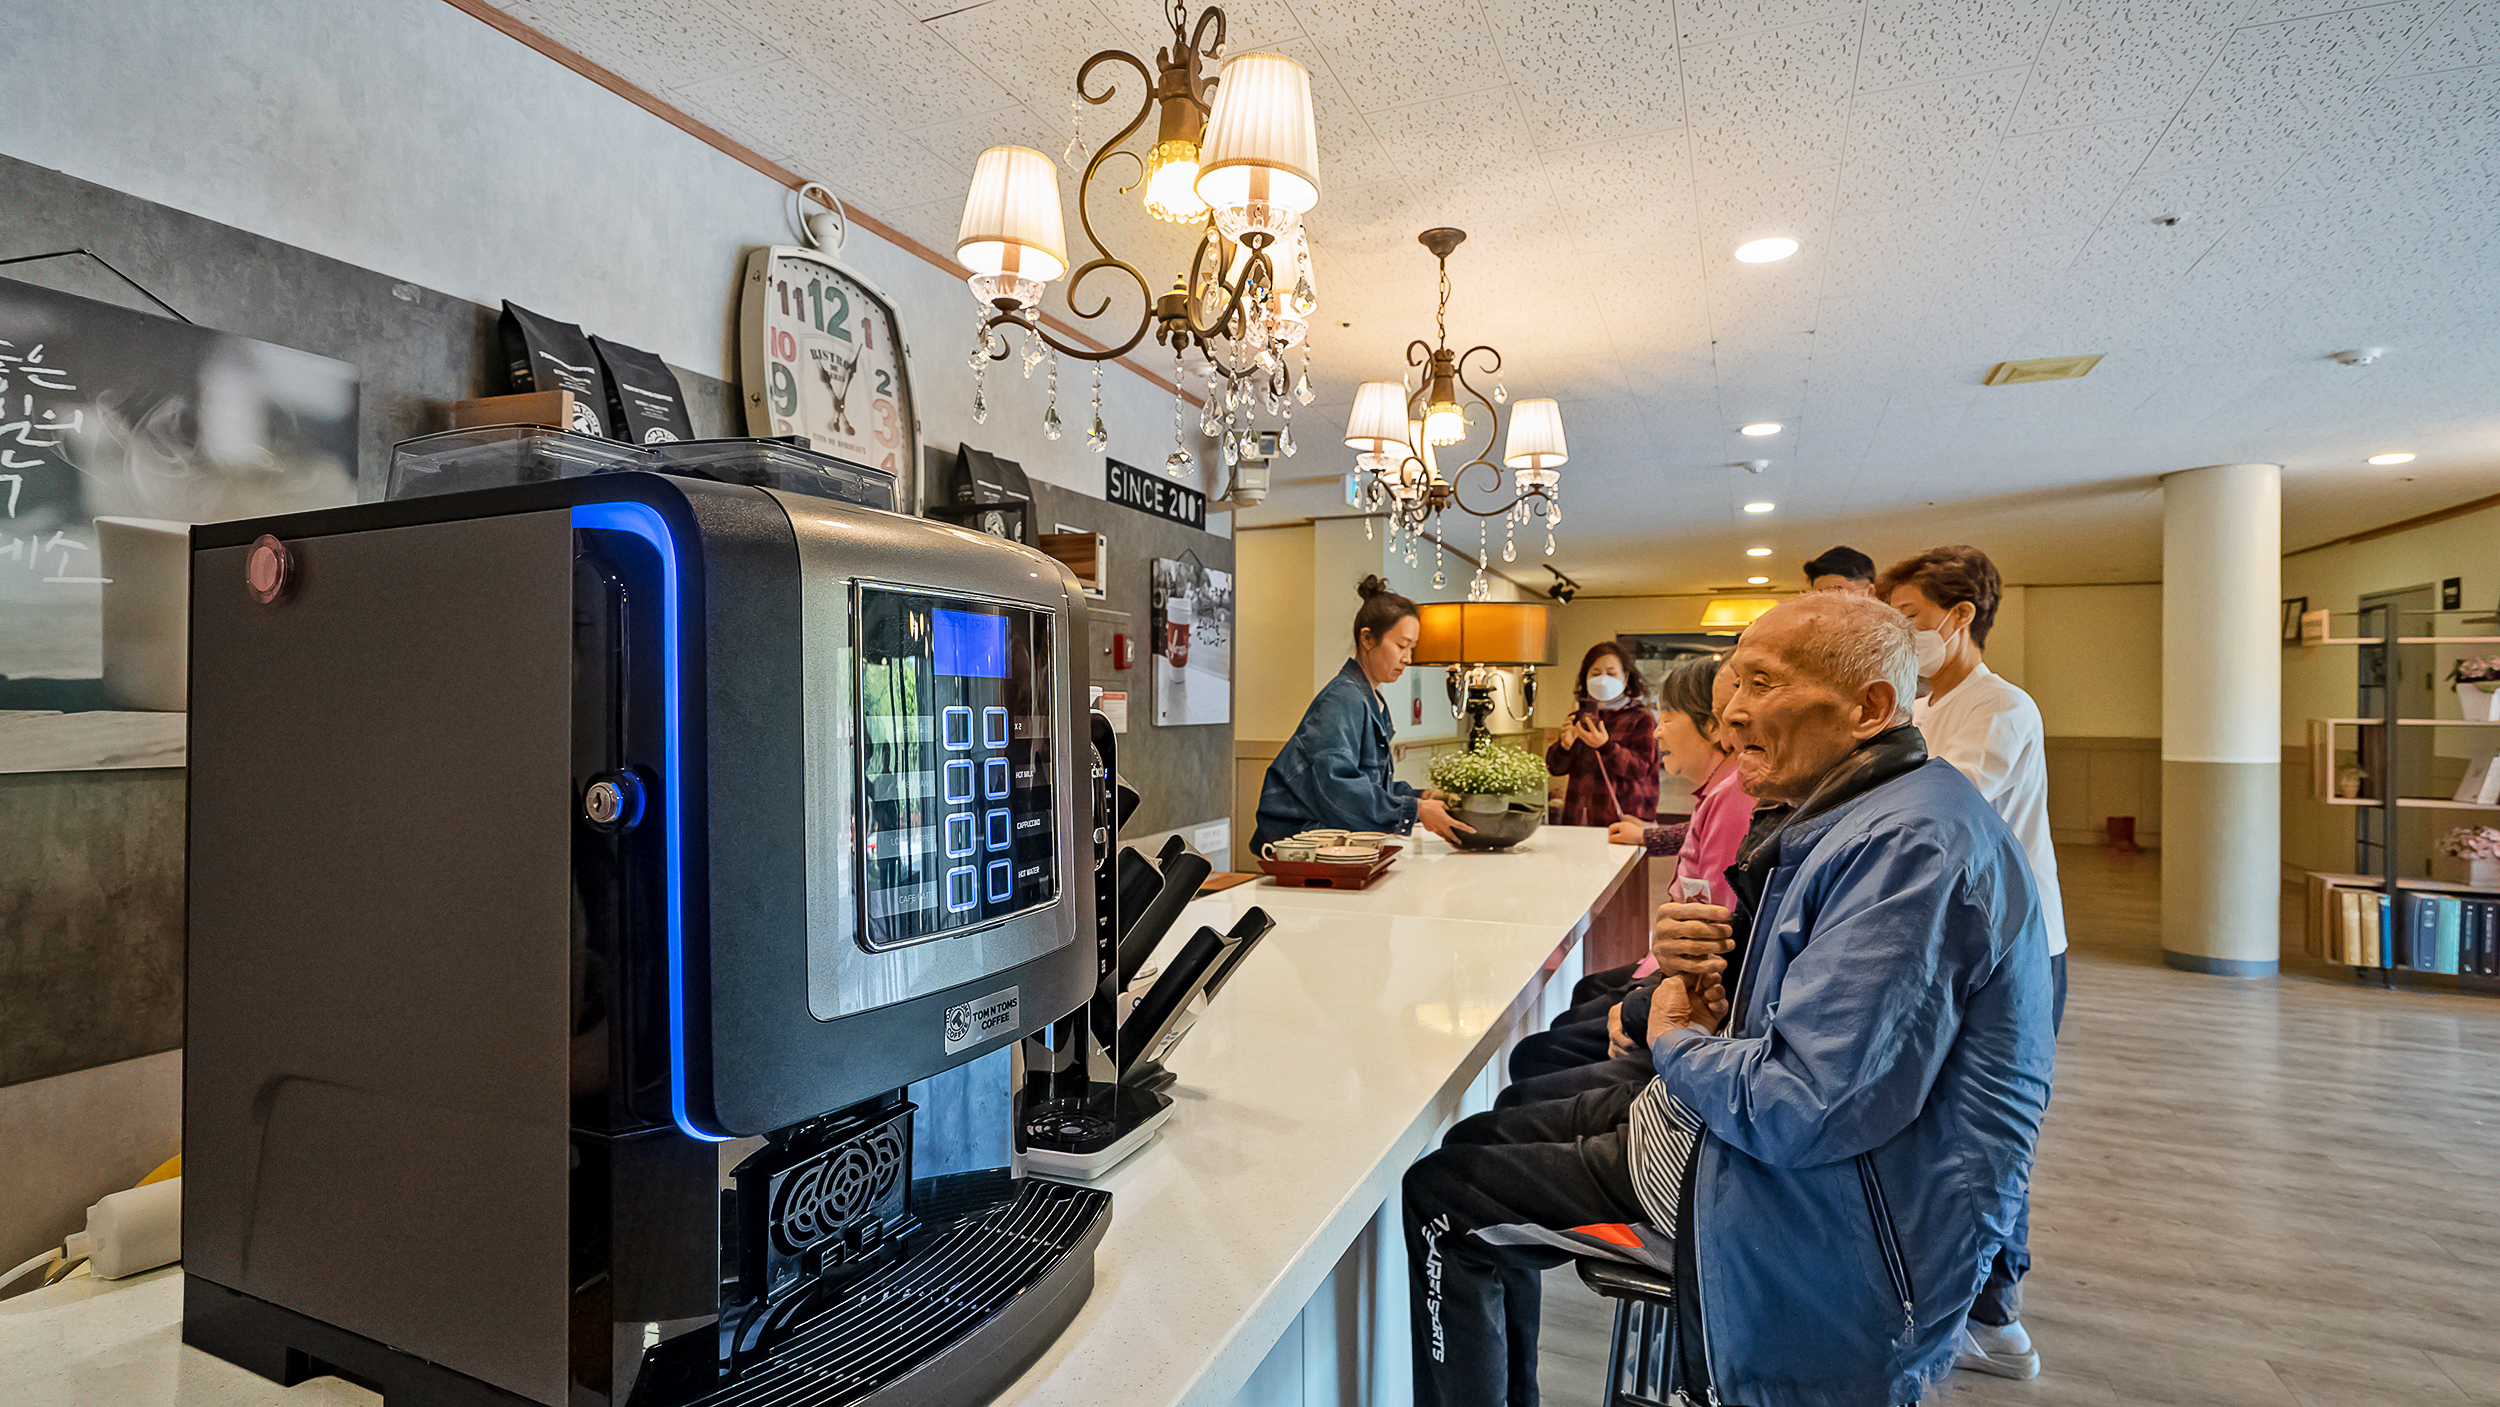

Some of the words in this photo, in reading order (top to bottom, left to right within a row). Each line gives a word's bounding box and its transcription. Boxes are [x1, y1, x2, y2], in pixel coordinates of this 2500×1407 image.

[777, 279, 805, 322] 11
[808, 278, 852, 343] 12
[771, 326, 797, 362] 10
[861, 317, 873, 350] 1
[771, 361, 798, 417] 9
[875, 369, 893, 397] 2
[872, 398, 900, 449] 3
[1111, 466, 1164, 513] SINCE
[1169, 488, 1204, 525] 2001
[972, 1008, 990, 1022] TOM
[991, 1005, 996, 1016] N
[997, 998, 1018, 1013] TOMS
[981, 1012, 1010, 1030] COFFEE
